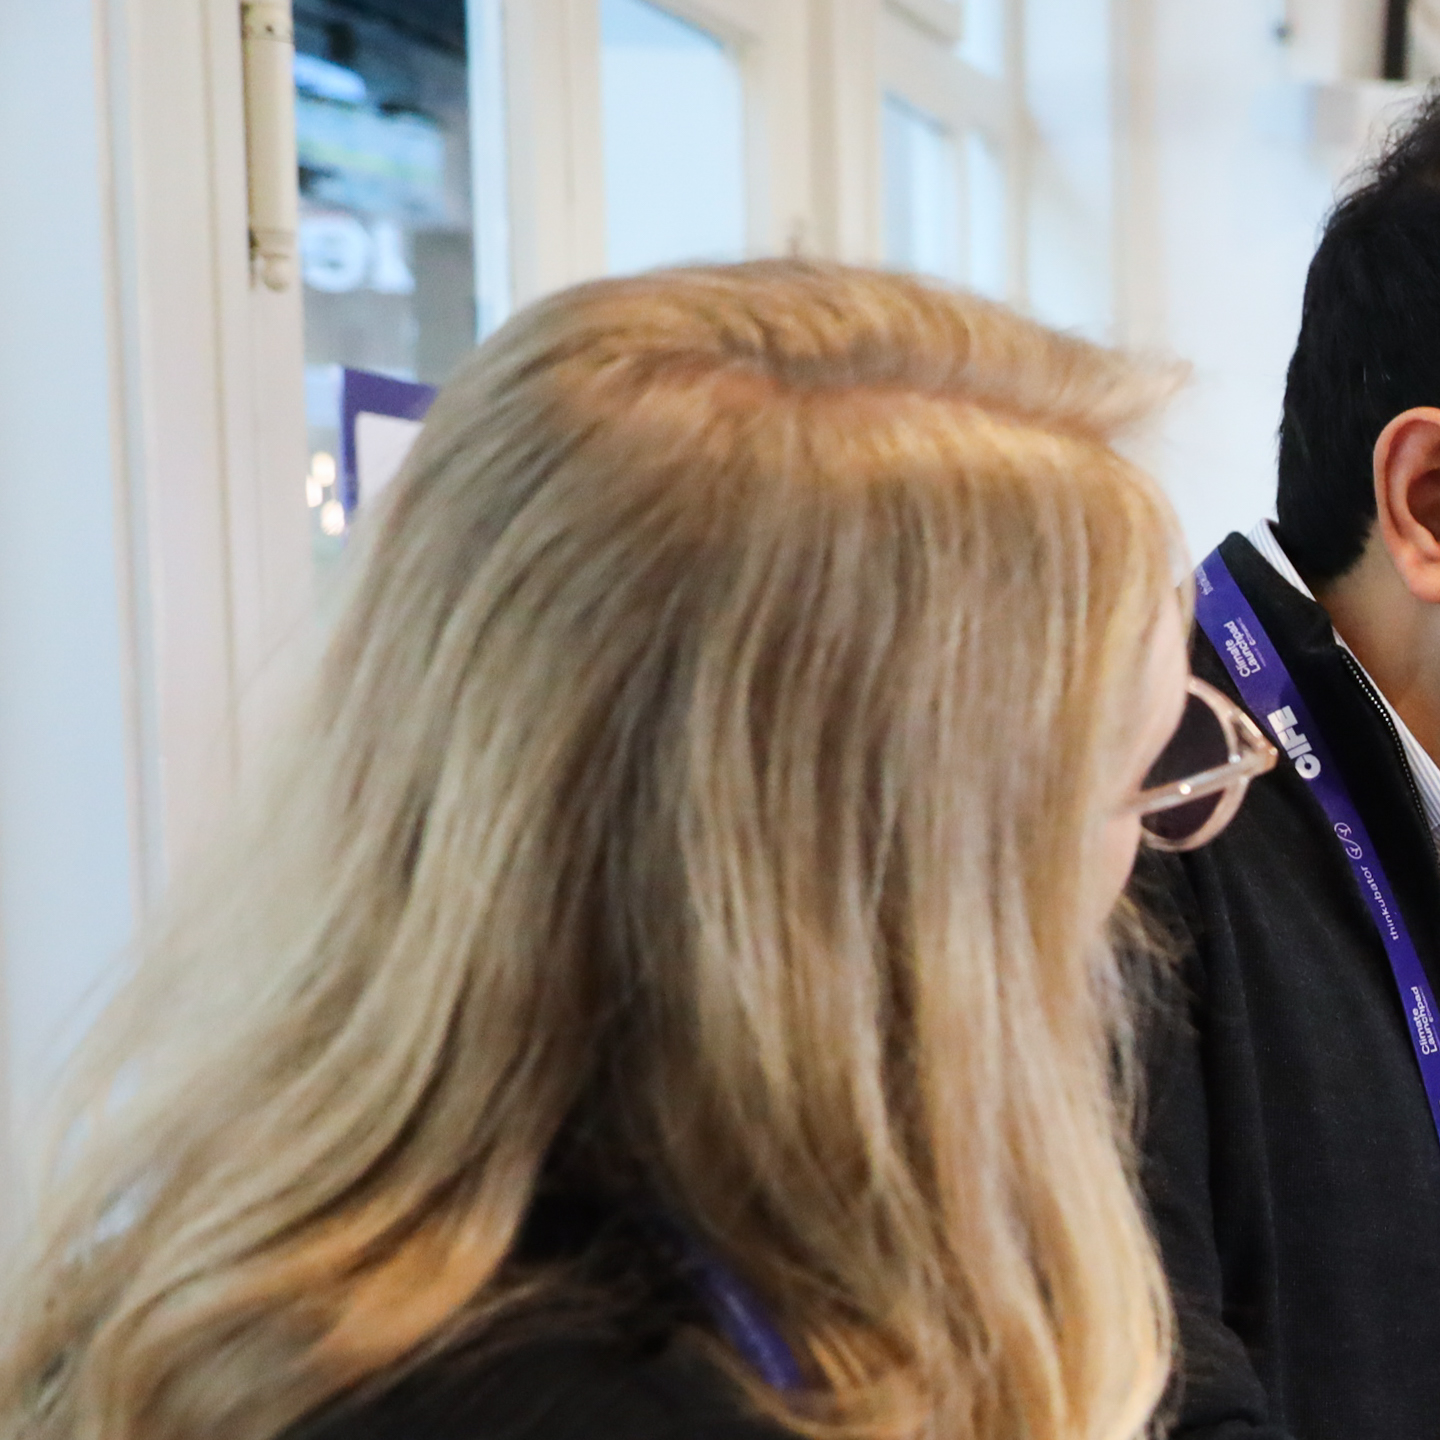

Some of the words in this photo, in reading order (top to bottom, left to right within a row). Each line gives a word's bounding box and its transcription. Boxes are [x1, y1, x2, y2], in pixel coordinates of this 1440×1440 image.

[1223, 620, 1262, 673] Launchpad
[1225, 639, 1250, 678] Climate
[1360, 865, 1400, 941] thinkubator
[1410, 986, 1438, 1053] Launchpad
[1412, 1008, 1430, 1055] Climate
